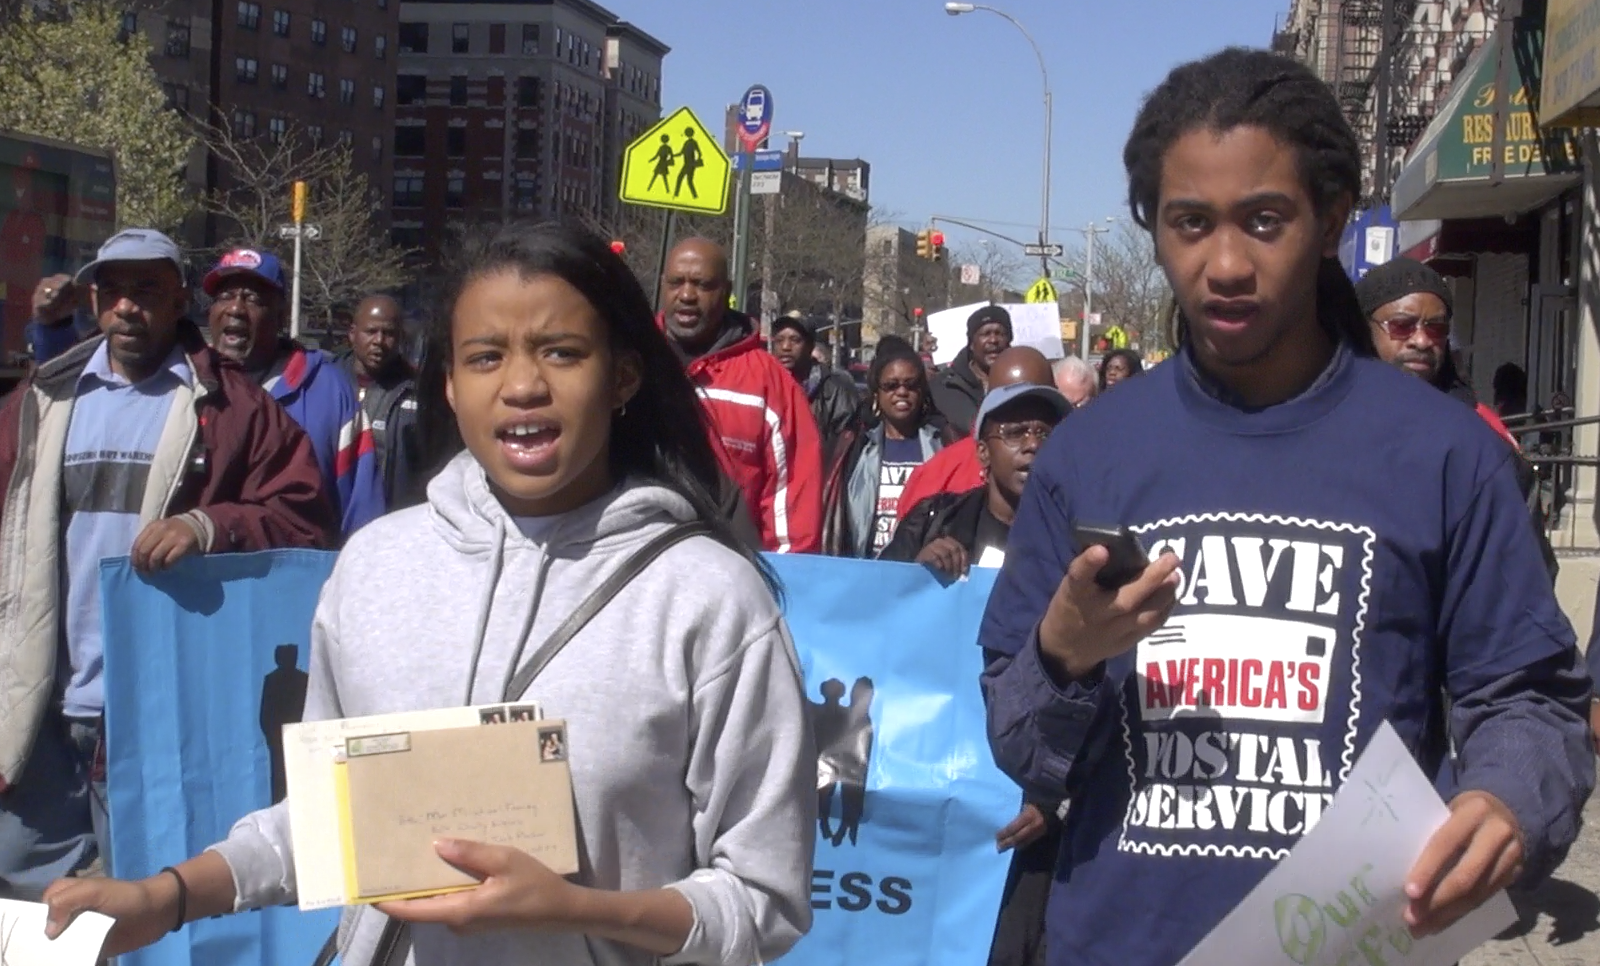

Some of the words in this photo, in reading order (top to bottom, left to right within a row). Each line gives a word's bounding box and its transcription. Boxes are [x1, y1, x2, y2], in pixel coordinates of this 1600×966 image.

[1463, 112, 1537, 143] RESAUR
[1472, 145, 1514, 165] FRE
[1143, 731, 1332, 788] POSTAL
